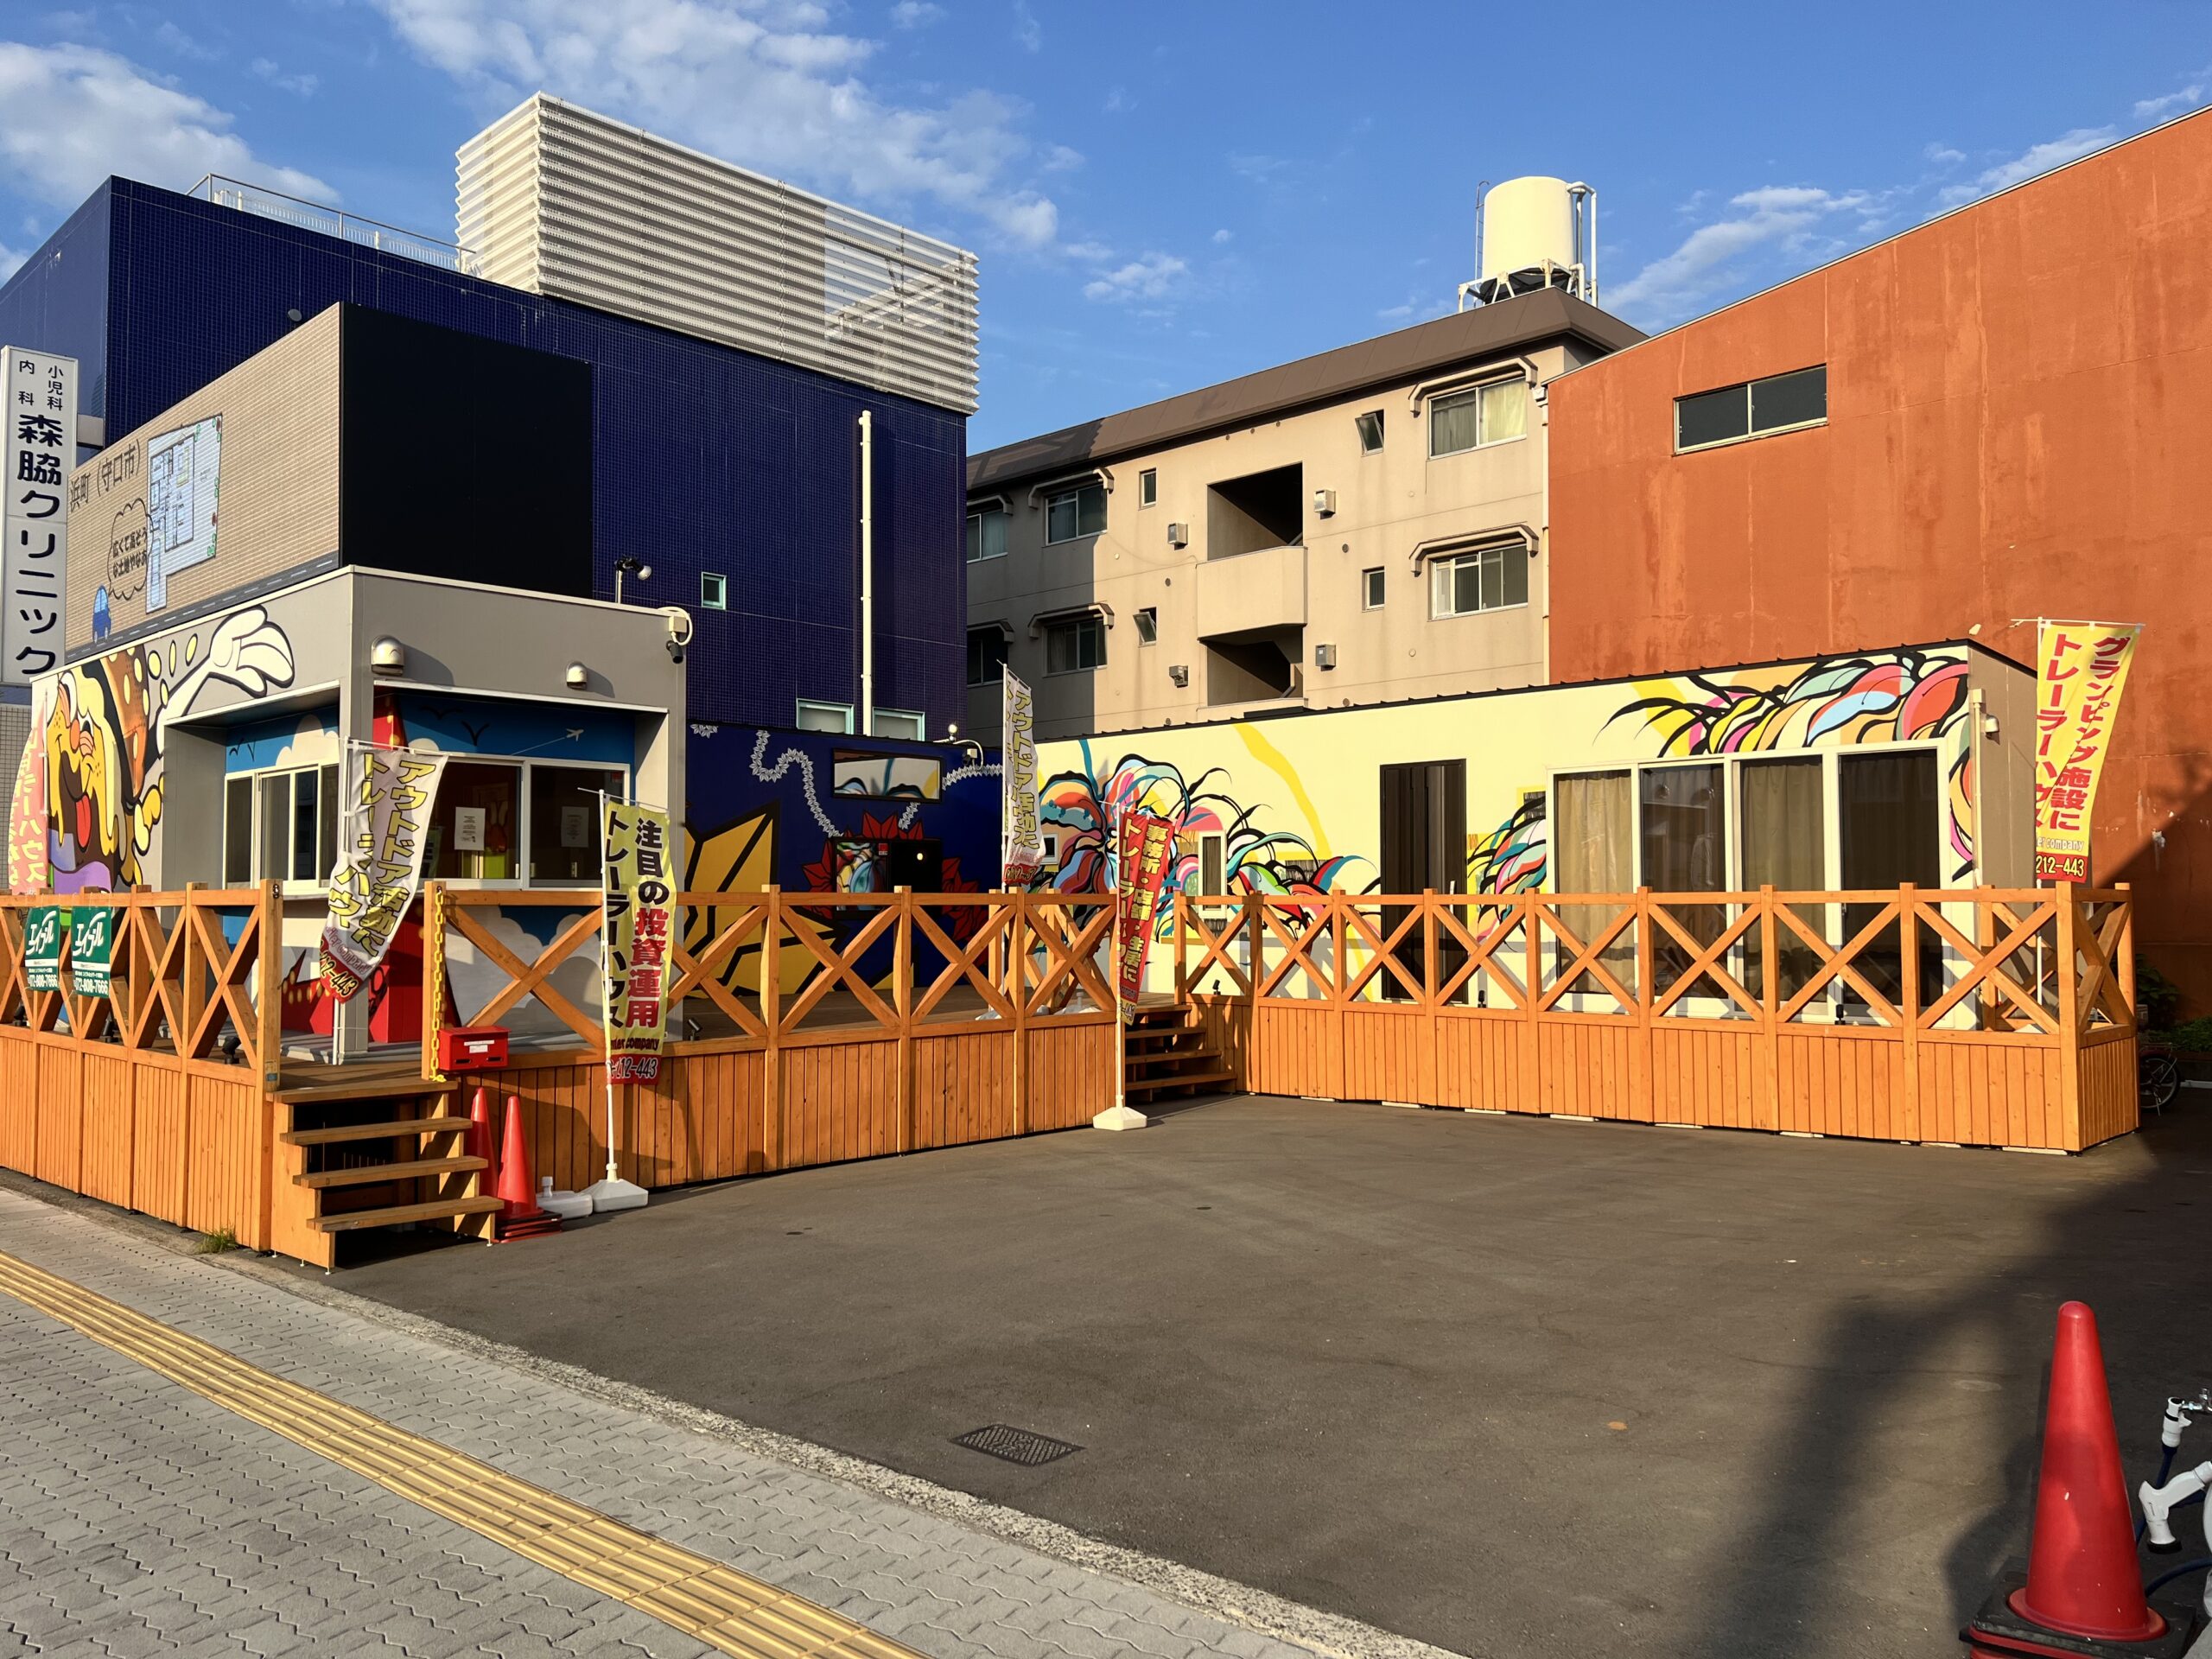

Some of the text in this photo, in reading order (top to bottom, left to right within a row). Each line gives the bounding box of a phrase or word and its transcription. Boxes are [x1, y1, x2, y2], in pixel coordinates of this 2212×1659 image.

[18, 360, 35, 406] 内科
[47, 365, 64, 411] 小児科
[16, 414, 63, 674] 森脇クリニック
[2050, 636, 2131, 831] グランピング施設に
[2046, 837, 2084, 852] company
[626, 818, 669, 1028] 注目の投資運用
[626, 1037, 659, 1052] company
